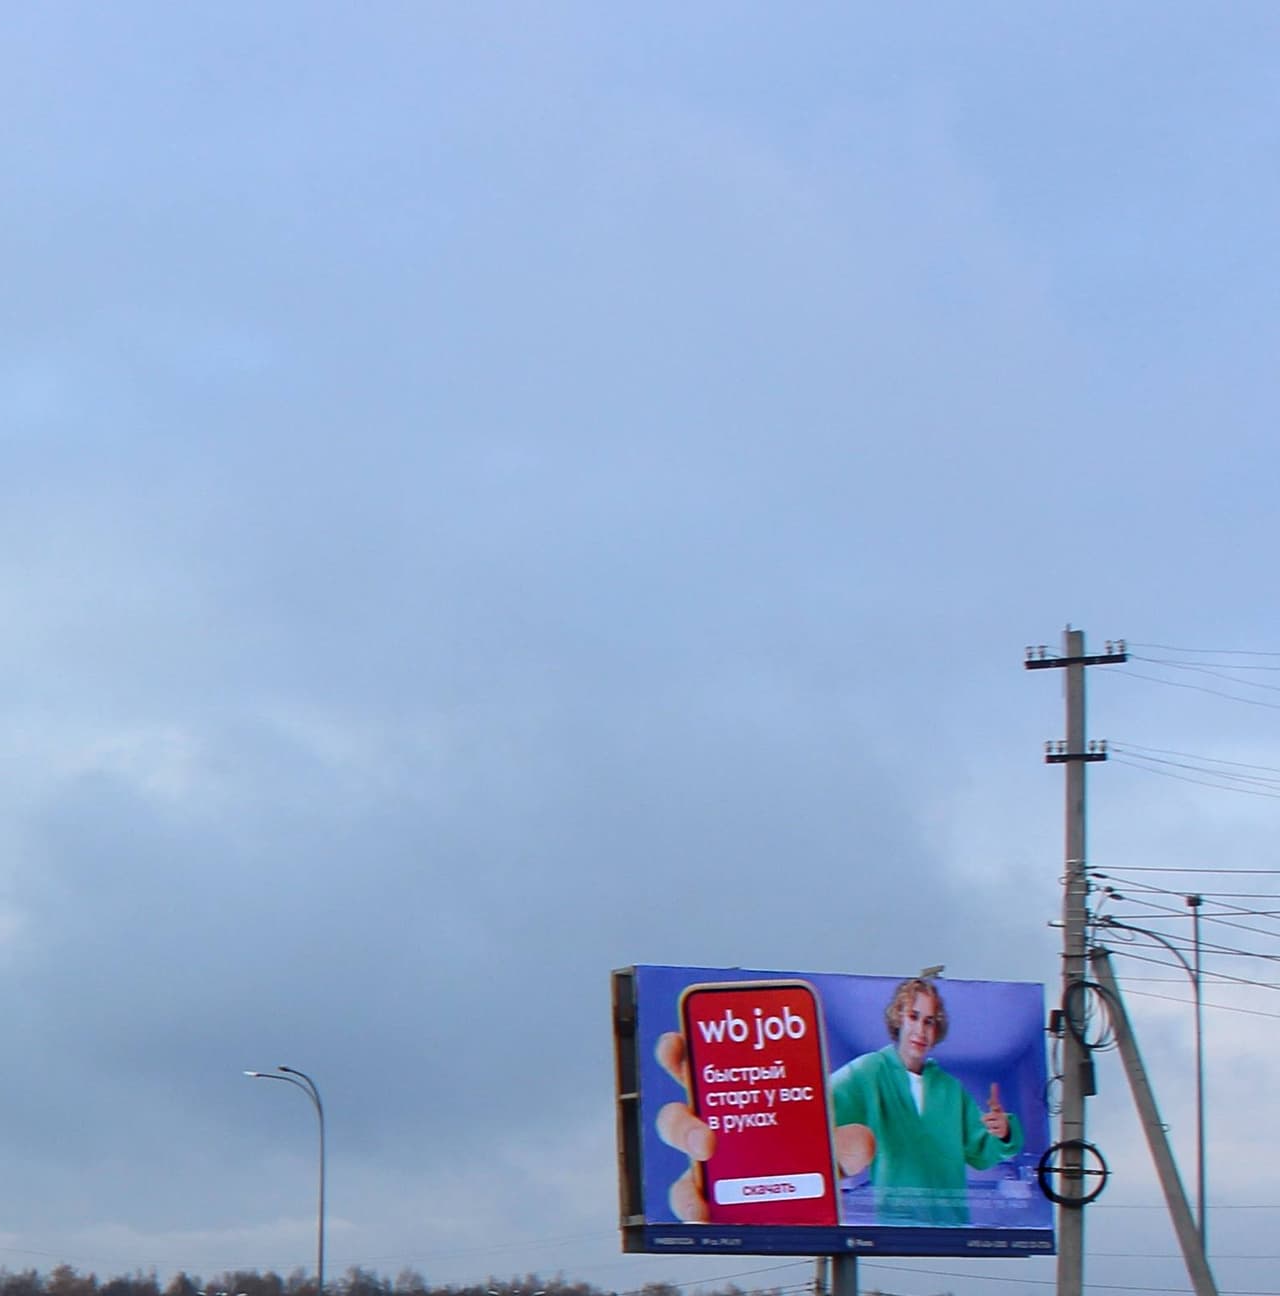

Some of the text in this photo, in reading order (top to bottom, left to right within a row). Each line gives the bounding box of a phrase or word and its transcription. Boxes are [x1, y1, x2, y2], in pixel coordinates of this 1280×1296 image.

[698, 1006, 806, 1050] wb job
[703, 1060, 786, 1085] быстрый
[706, 1086, 814, 1109] старт у вас
[708, 1111, 778, 1133] в руках
[742, 1181, 796, 1197] скачать
